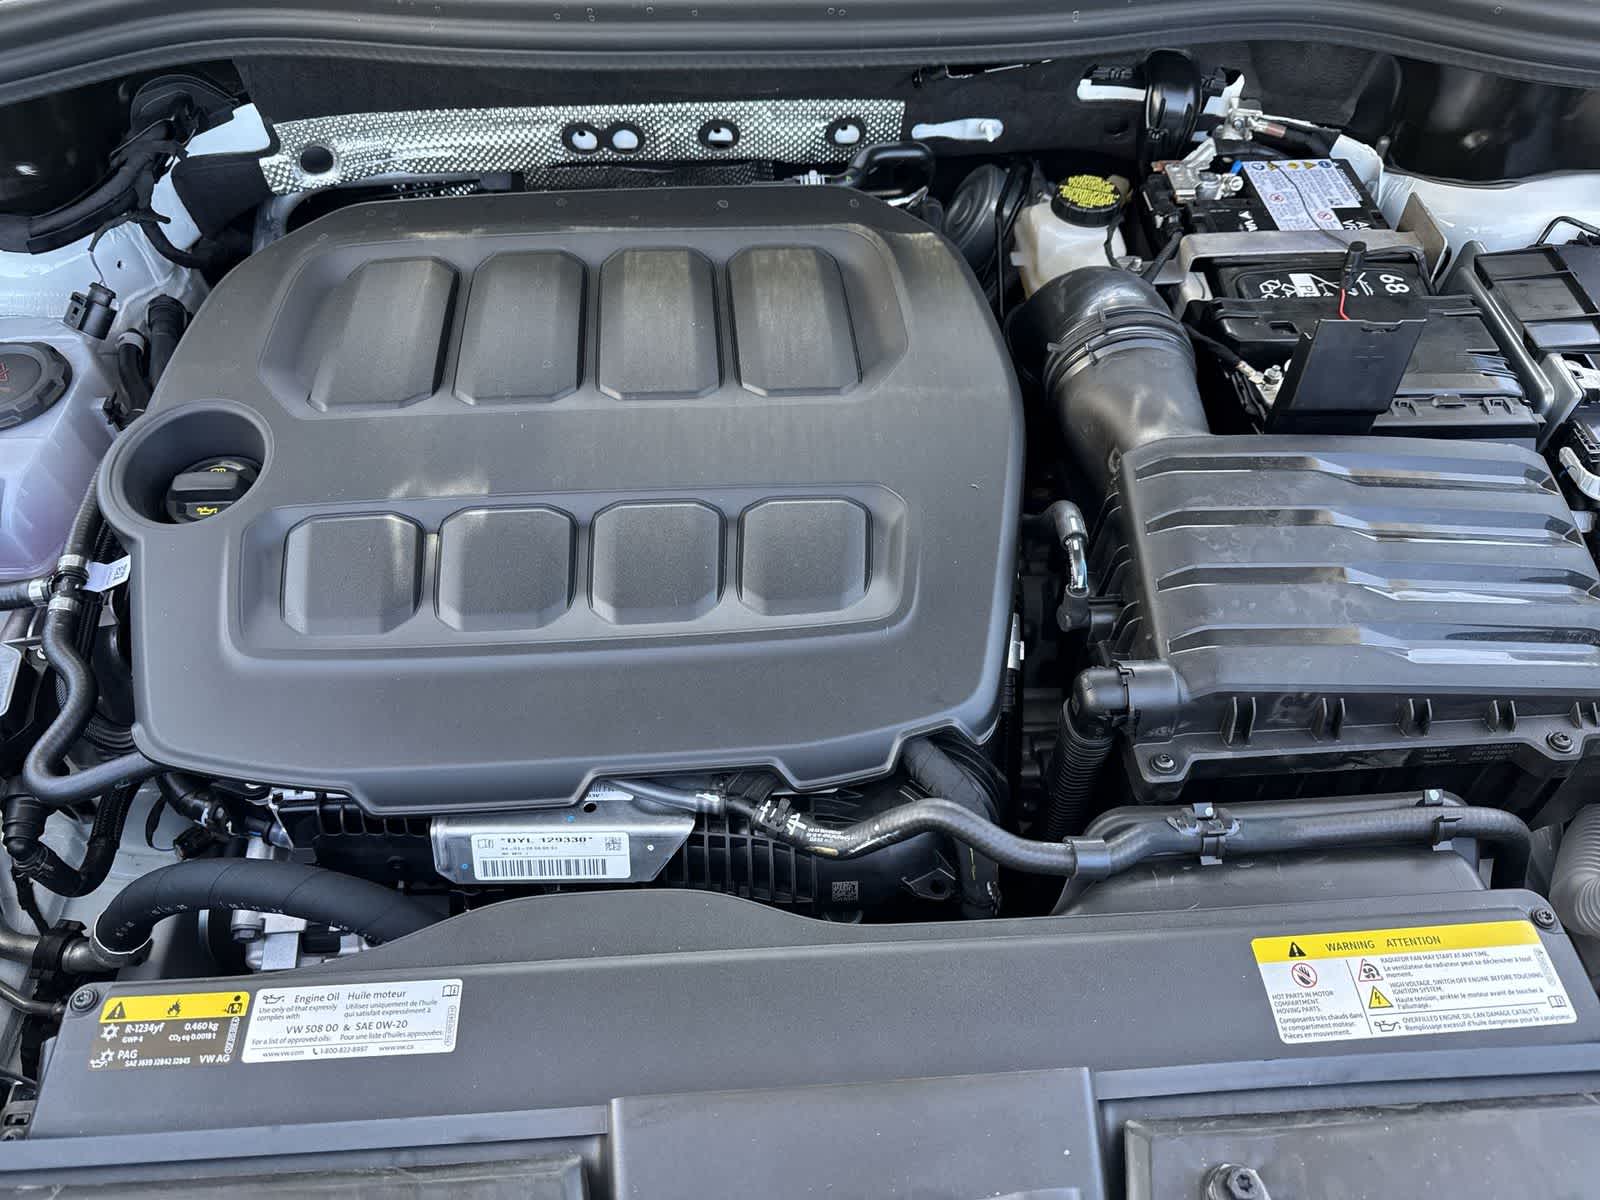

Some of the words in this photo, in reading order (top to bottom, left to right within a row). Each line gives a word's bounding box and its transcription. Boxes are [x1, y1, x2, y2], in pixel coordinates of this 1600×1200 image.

[1325, 940, 1375, 952] WARNING
[1386, 936, 1441, 947] ATTENTION
[295, 993, 324, 1005] Engine
[327, 992, 340, 1001] Oil
[347, 991, 371, 1000] Huile
[373, 989, 407, 999] moteur
[125, 1022, 165, 1036] R-1234yf
[184, 1022, 207, 1032] 0.460
[208, 1021, 219, 1032] kg
[286, 1025, 303, 1035] VW
[305, 1024, 323, 1033] 508
[325, 1023, 339, 1032] 00
[343, 1023, 351, 1031] &
[355, 1022, 374, 1031] SAE
[376, 1020, 408, 1030] 0W-20
[117, 1049, 138, 1059] PAG
[199, 1054, 216, 1064] VW
[216, 1053, 231, 1063] AG
